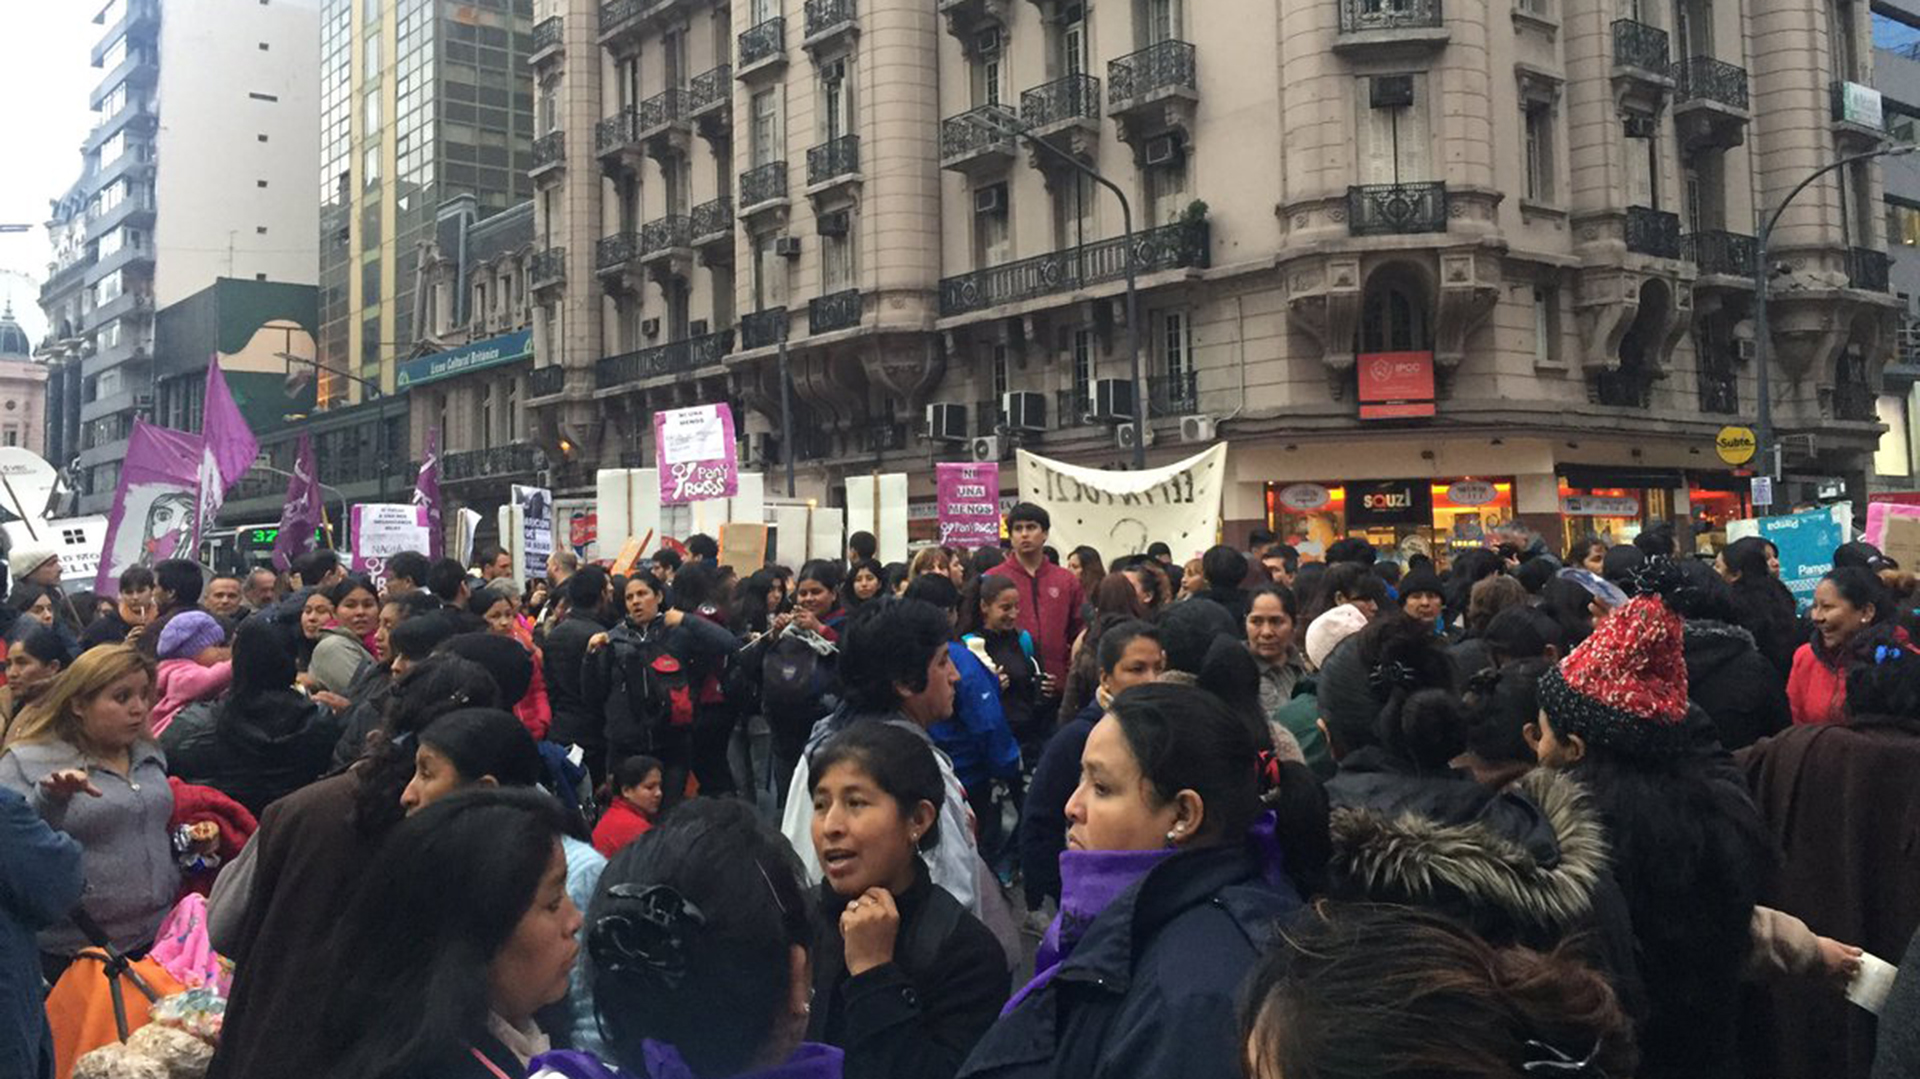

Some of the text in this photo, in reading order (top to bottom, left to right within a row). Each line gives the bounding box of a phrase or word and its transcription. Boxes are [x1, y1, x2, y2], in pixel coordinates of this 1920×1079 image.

[1717, 437, 1755, 449] Subte
[957, 486, 983, 496] UNA
[948, 504, 993, 514] MENOS
[1798, 563, 1833, 576] Pampa
